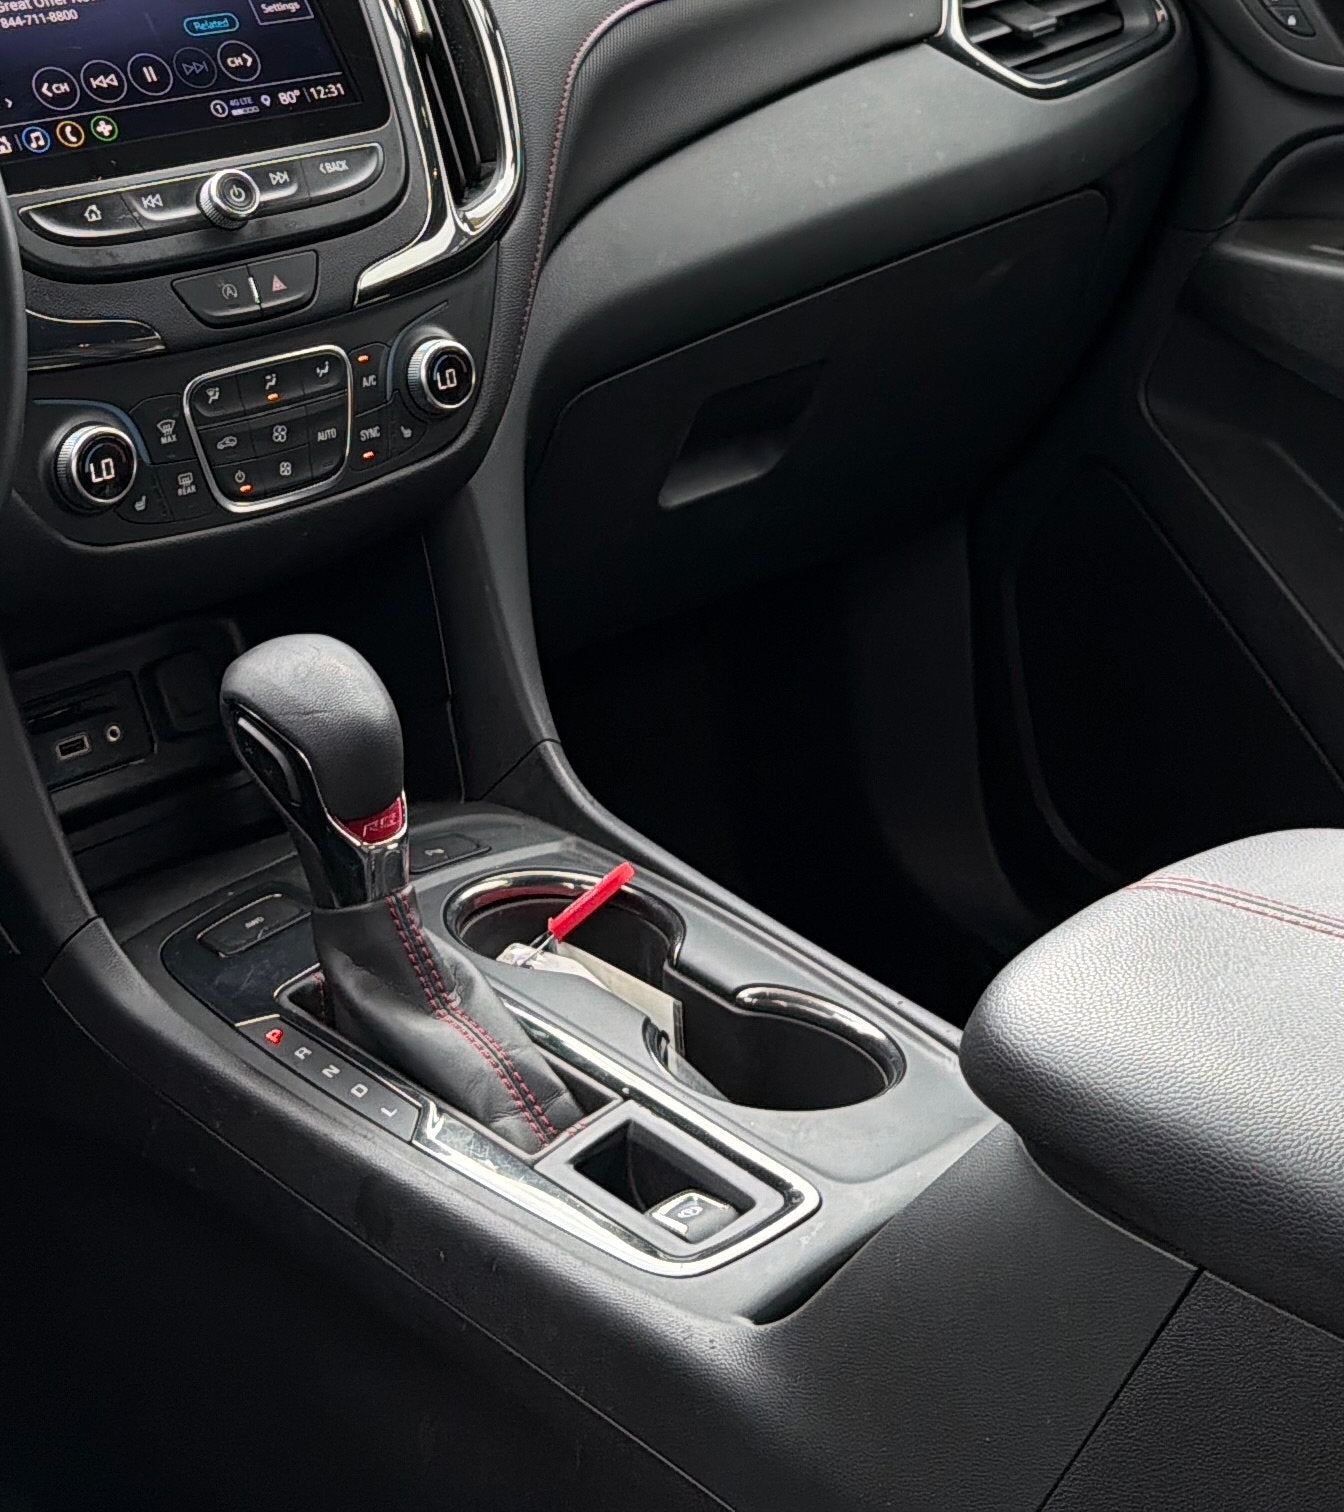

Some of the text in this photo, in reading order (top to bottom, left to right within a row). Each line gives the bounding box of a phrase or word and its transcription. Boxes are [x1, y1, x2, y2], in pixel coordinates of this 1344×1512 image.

[260, 0, 301, 15] Settings
[0, 8, 79, 29] 844-711-8800
[192, 17, 230, 31] Related
[226, 56, 244, 68] CH
[51, 82, 71, 94] CH
[240, 96, 255, 106] LTE
[277, 88, 301, 105] 80°
[310, 82, 346, 100] 12:31
[324, 159, 350, 173] BACK
[361, 374, 377, 389] A/C
[160, 434, 178, 445] MAX
[316, 427, 338, 442] AUTO
[359, 425, 381, 442] SYNC
[177, 484, 197, 497] REAR
[265, 1027, 284, 1045] P
[293, 1045, 313, 1061] R
[321, 1063, 341, 1079] N
[350, 1083, 369, 1099] D
[380, 1106, 398, 1118] L
